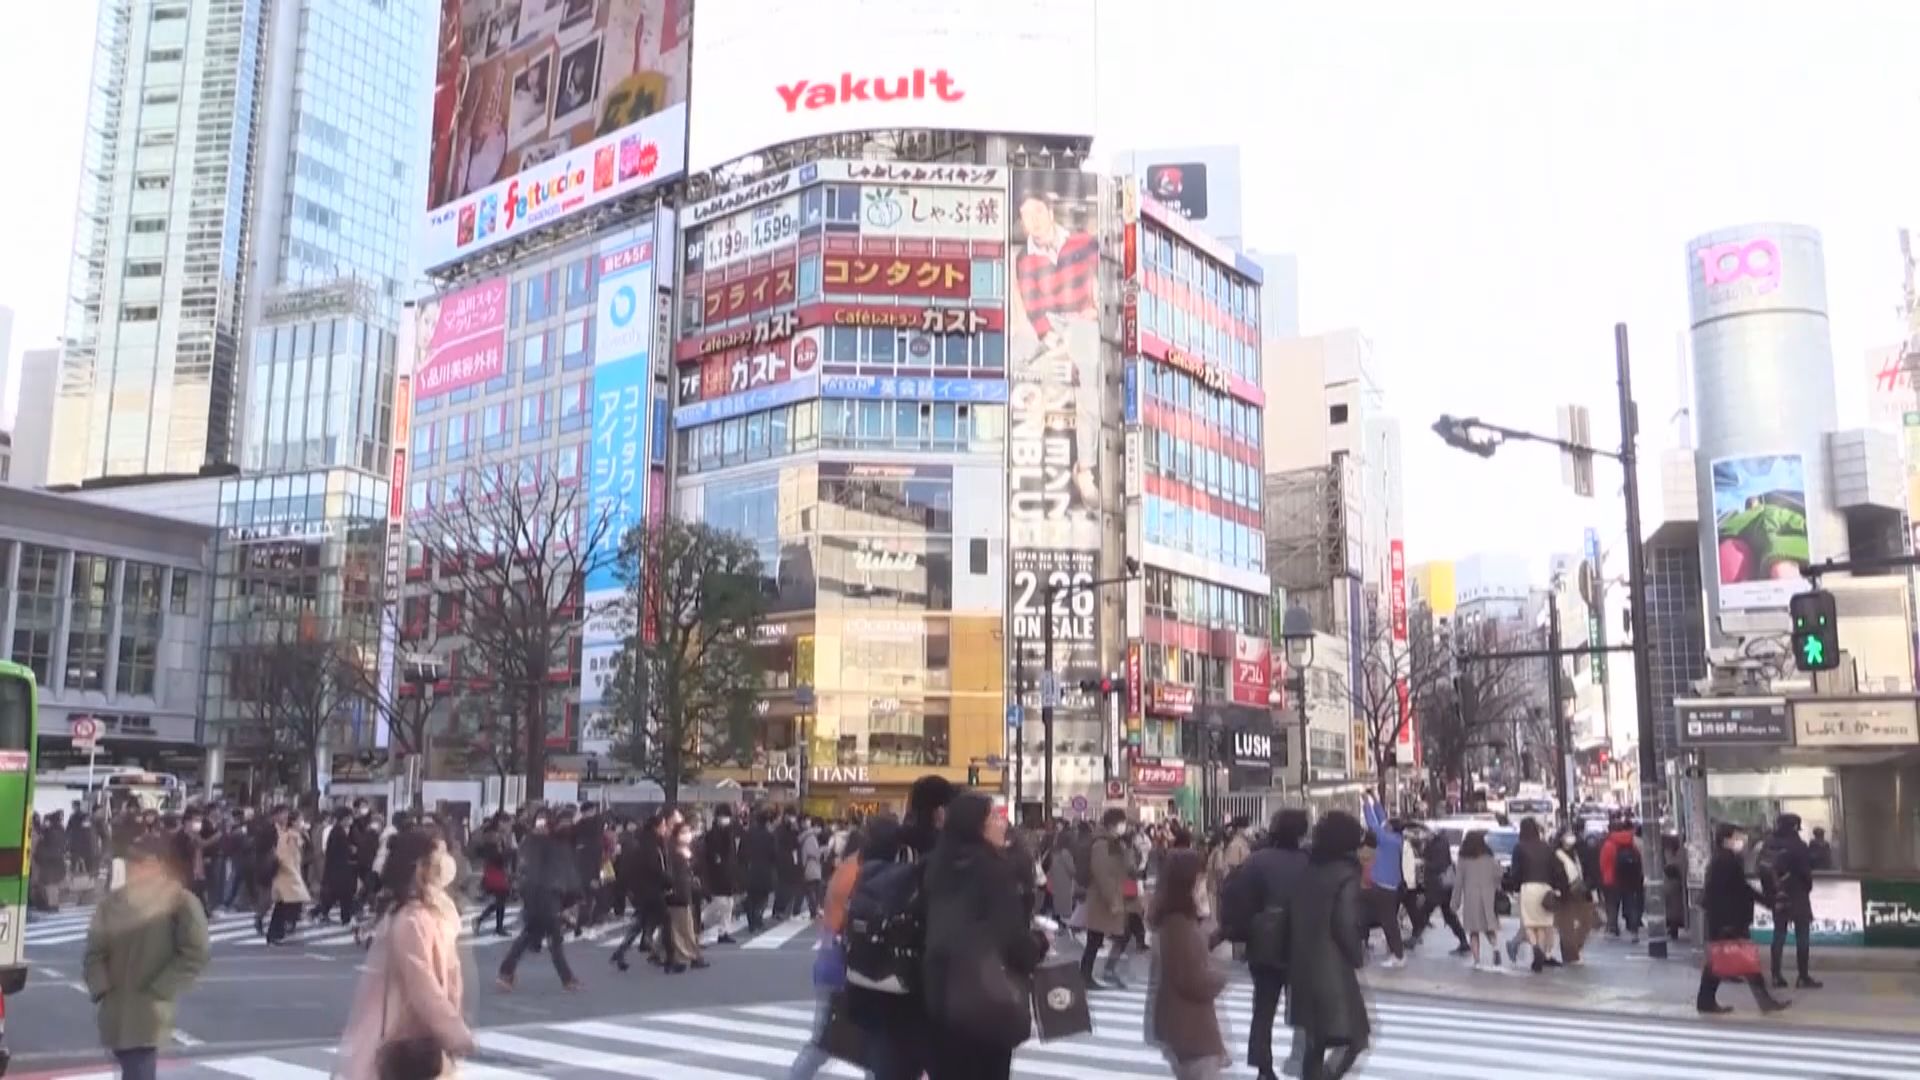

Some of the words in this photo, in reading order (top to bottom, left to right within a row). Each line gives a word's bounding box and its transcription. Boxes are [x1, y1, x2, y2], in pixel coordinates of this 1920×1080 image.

[775, 67, 966, 114] Yakult
[911, 197, 1000, 226] しゃぶ葉
[824, 260, 965, 289] コンタクト
[1697, 239, 1782, 294] 109
[754, 312, 799, 344] ガスト
[921, 307, 988, 333] ガスト
[731, 352, 786, 391] ガスト
[228, 526, 281, 541] MARK
[1013, 571, 1095, 617] 2.26
[1013, 616, 1041, 638] ON
[1051, 617, 1095, 639] SALE
[1239, 663, 1264, 683] アコム
[1235, 732, 1271, 758] LUSH
[768, 763, 869, 782] L'OCITANE
